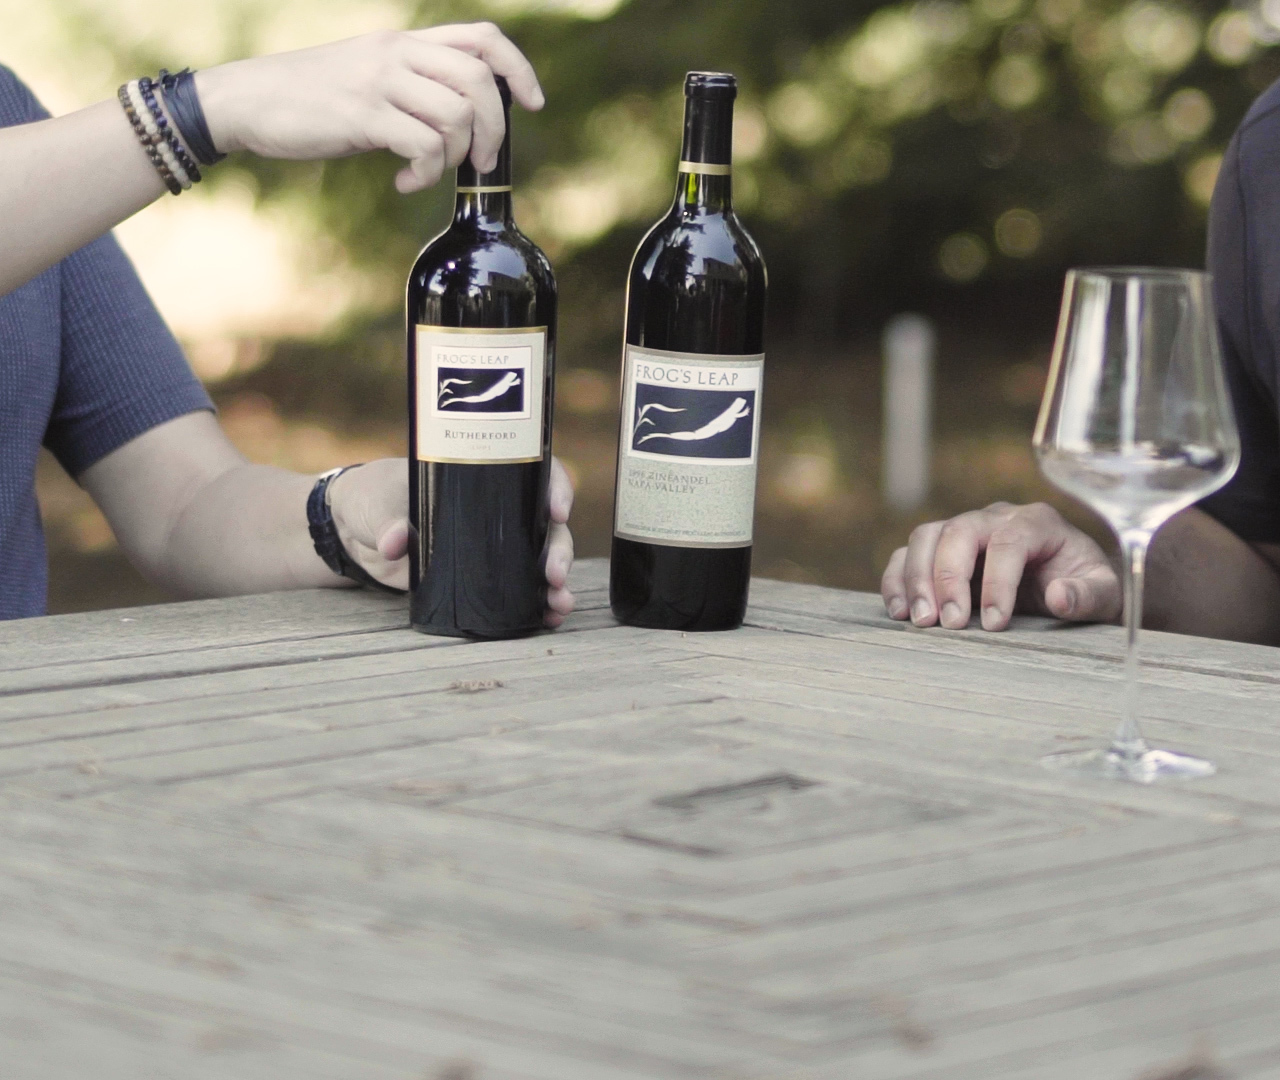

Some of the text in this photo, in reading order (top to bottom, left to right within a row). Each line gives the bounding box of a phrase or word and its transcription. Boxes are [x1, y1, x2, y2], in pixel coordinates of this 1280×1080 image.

[480, 355, 509, 365] LEAP
[636, 364, 739, 386] FROG'S LEAP
[655, 482, 696, 494] VALLEY
